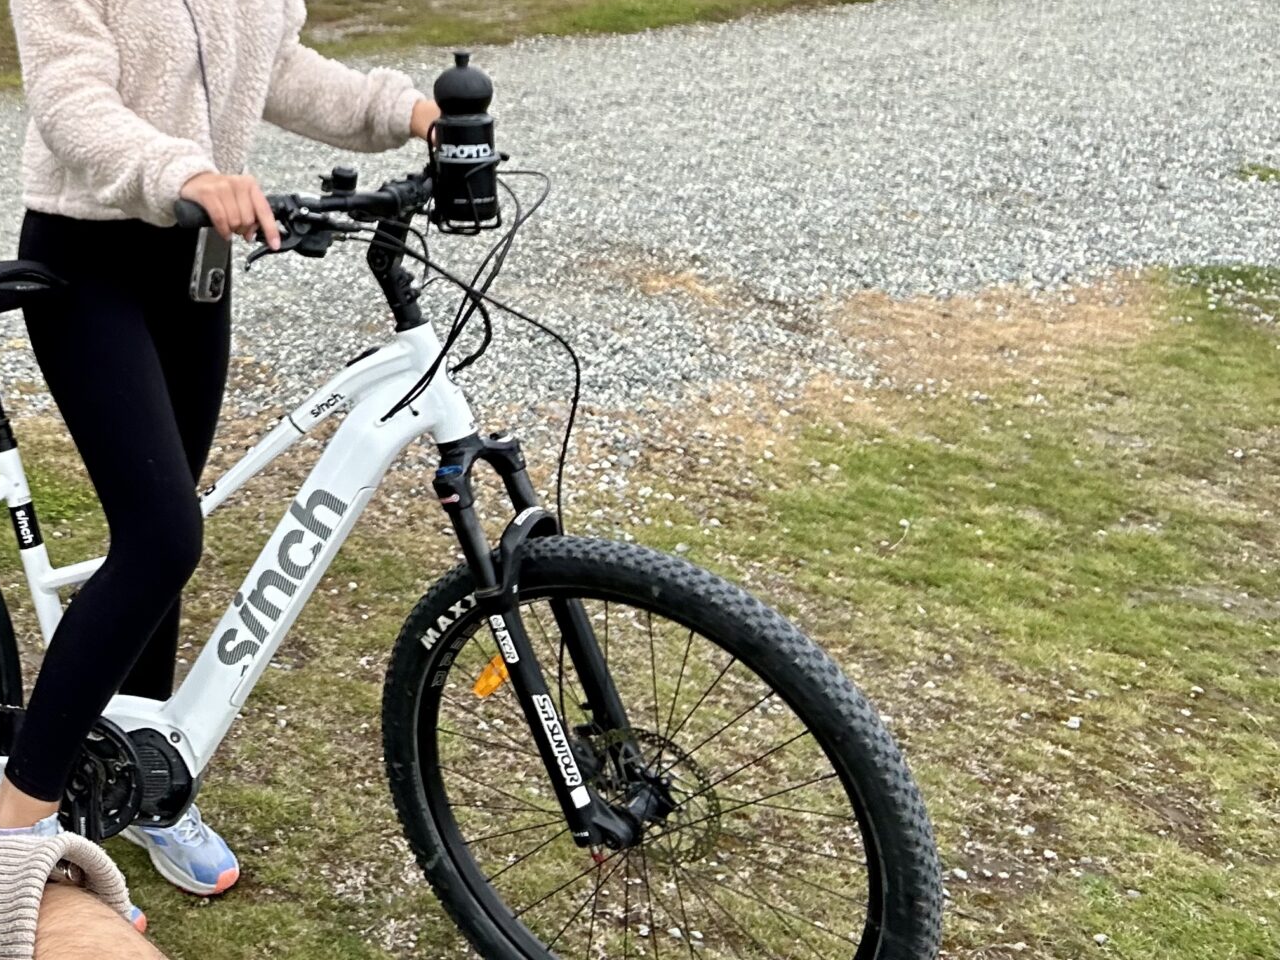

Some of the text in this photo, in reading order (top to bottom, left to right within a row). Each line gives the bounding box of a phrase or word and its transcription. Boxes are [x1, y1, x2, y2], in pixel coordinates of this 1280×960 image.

[217, 489, 348, 677] sinch
[420, 591, 478, 651] MAXX
[546, 723, 580, 783] SUNTOUR
